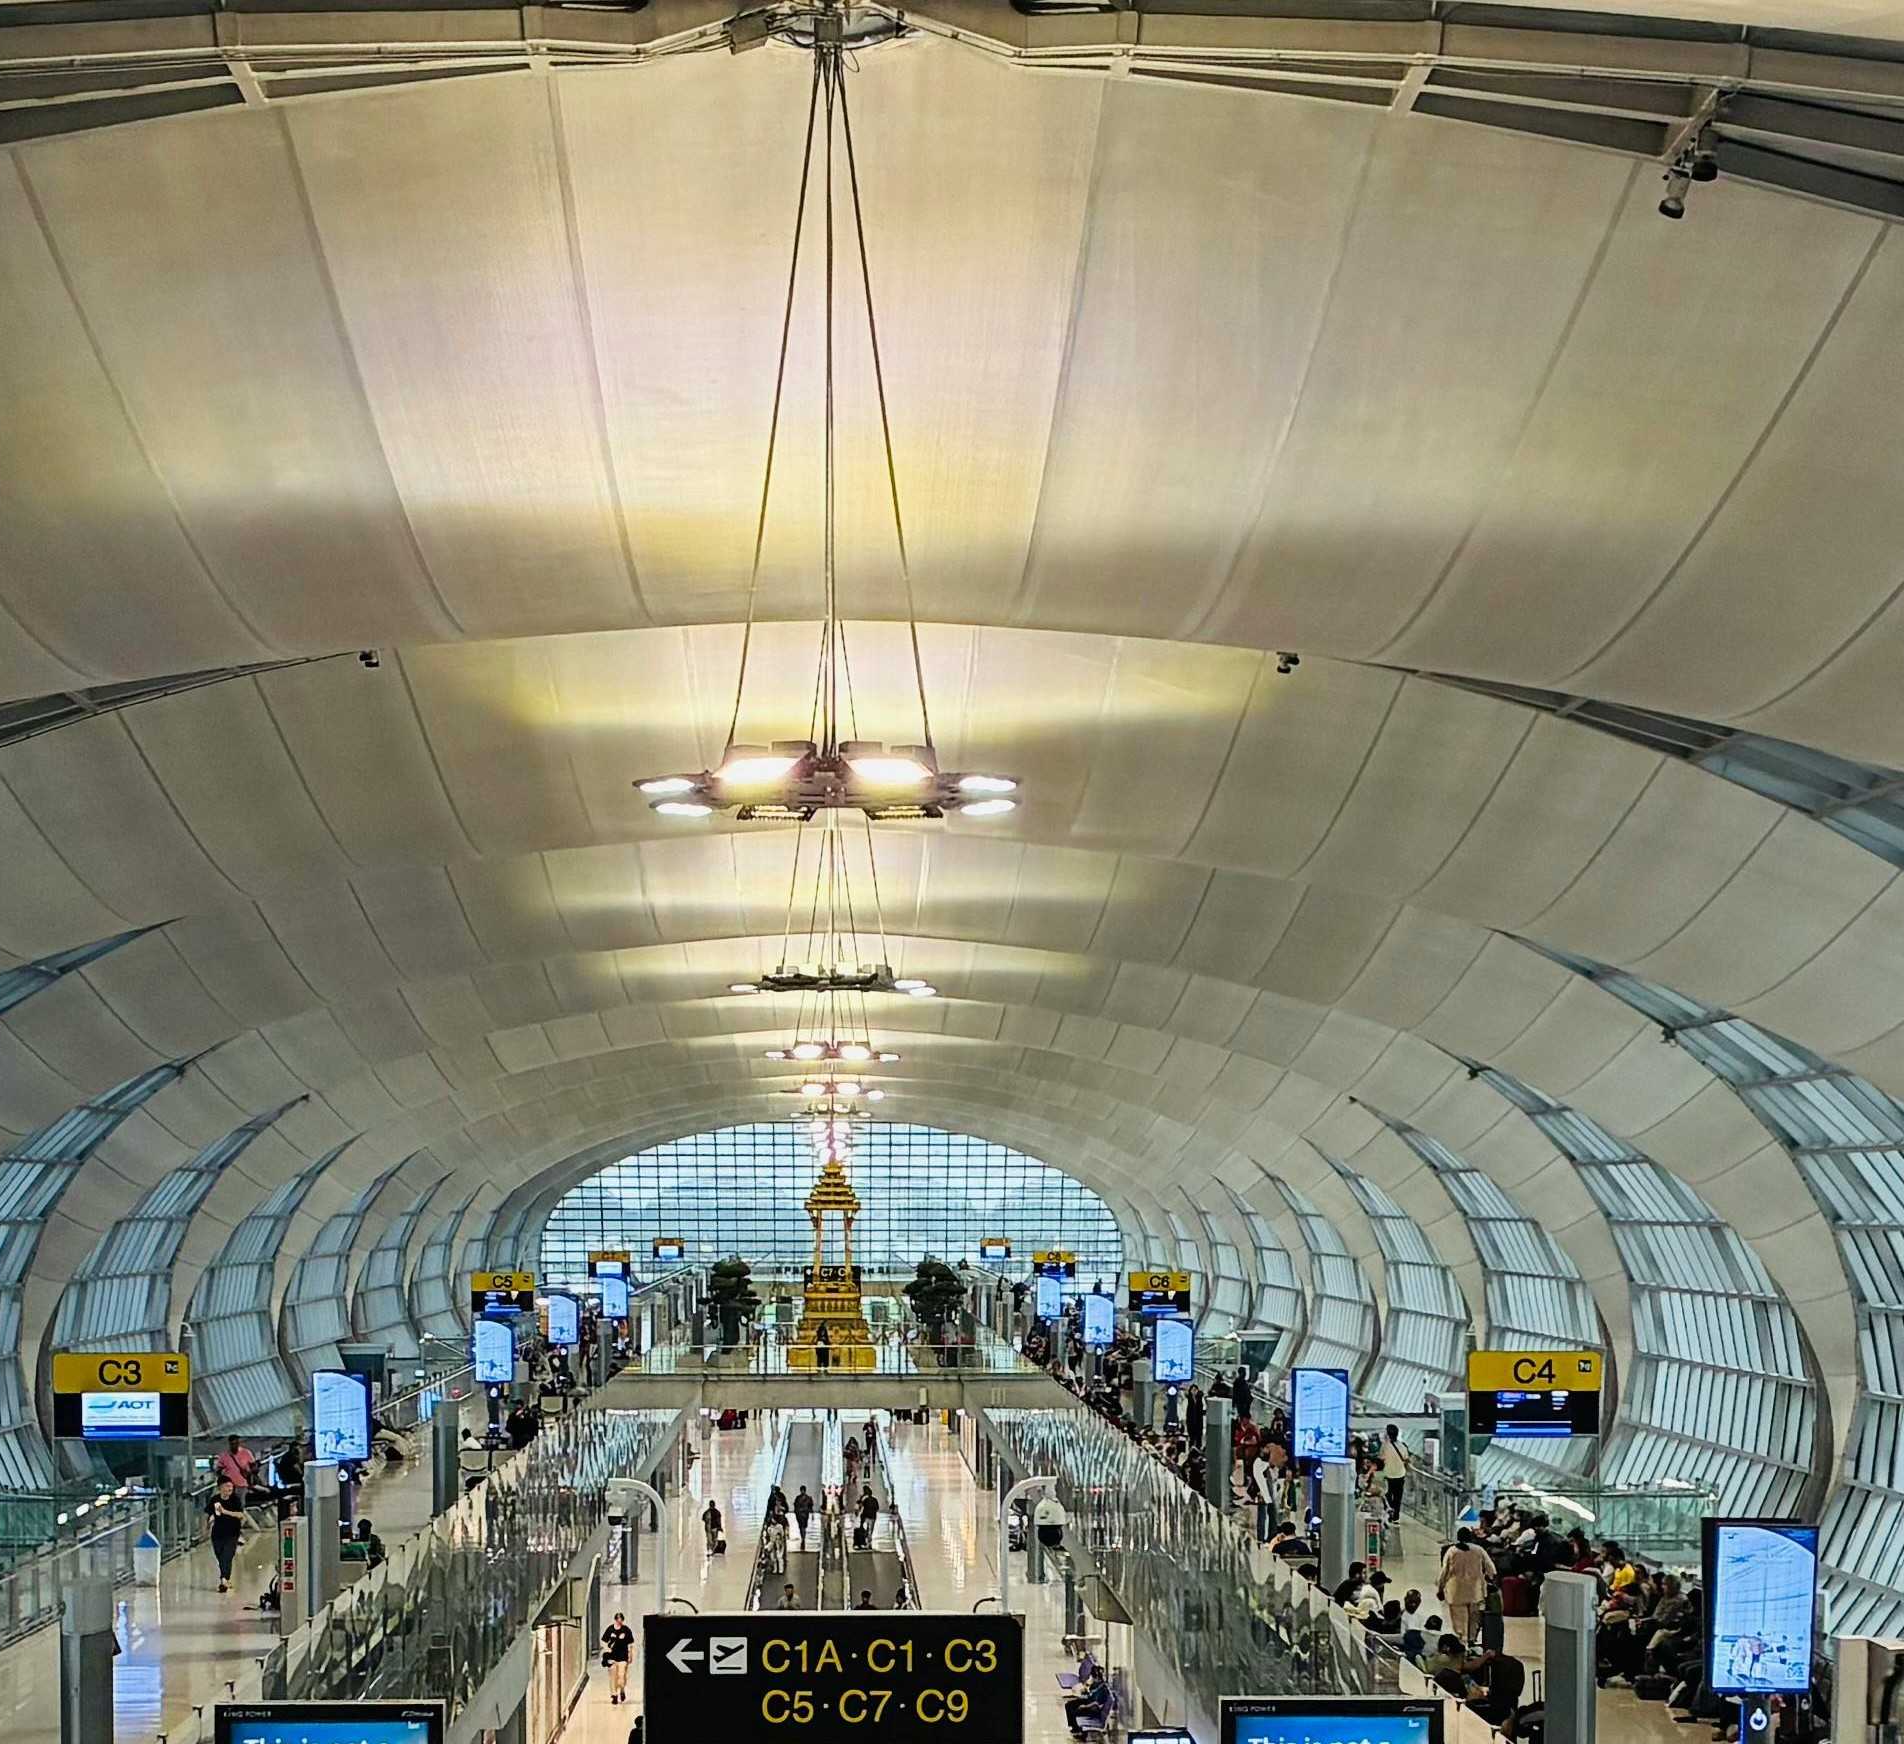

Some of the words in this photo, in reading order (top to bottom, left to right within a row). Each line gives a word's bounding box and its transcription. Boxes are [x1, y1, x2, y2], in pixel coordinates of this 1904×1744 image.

[493, 1275, 513, 1288] C5
[1149, 1276, 1170, 1289] C6
[99, 1360, 142, 1385] C3
[1513, 1359, 1556, 1384] C4
[118, 1401, 154, 1409] AOT
[761, 1639, 843, 1673] C1A
[867, 1639, 912, 1672] C1
[944, 1639, 997, 1672] C3
[761, 1690, 814, 1723] C5
[839, 1690, 892, 1723] C7
[916, 1689, 969, 1723] C9
